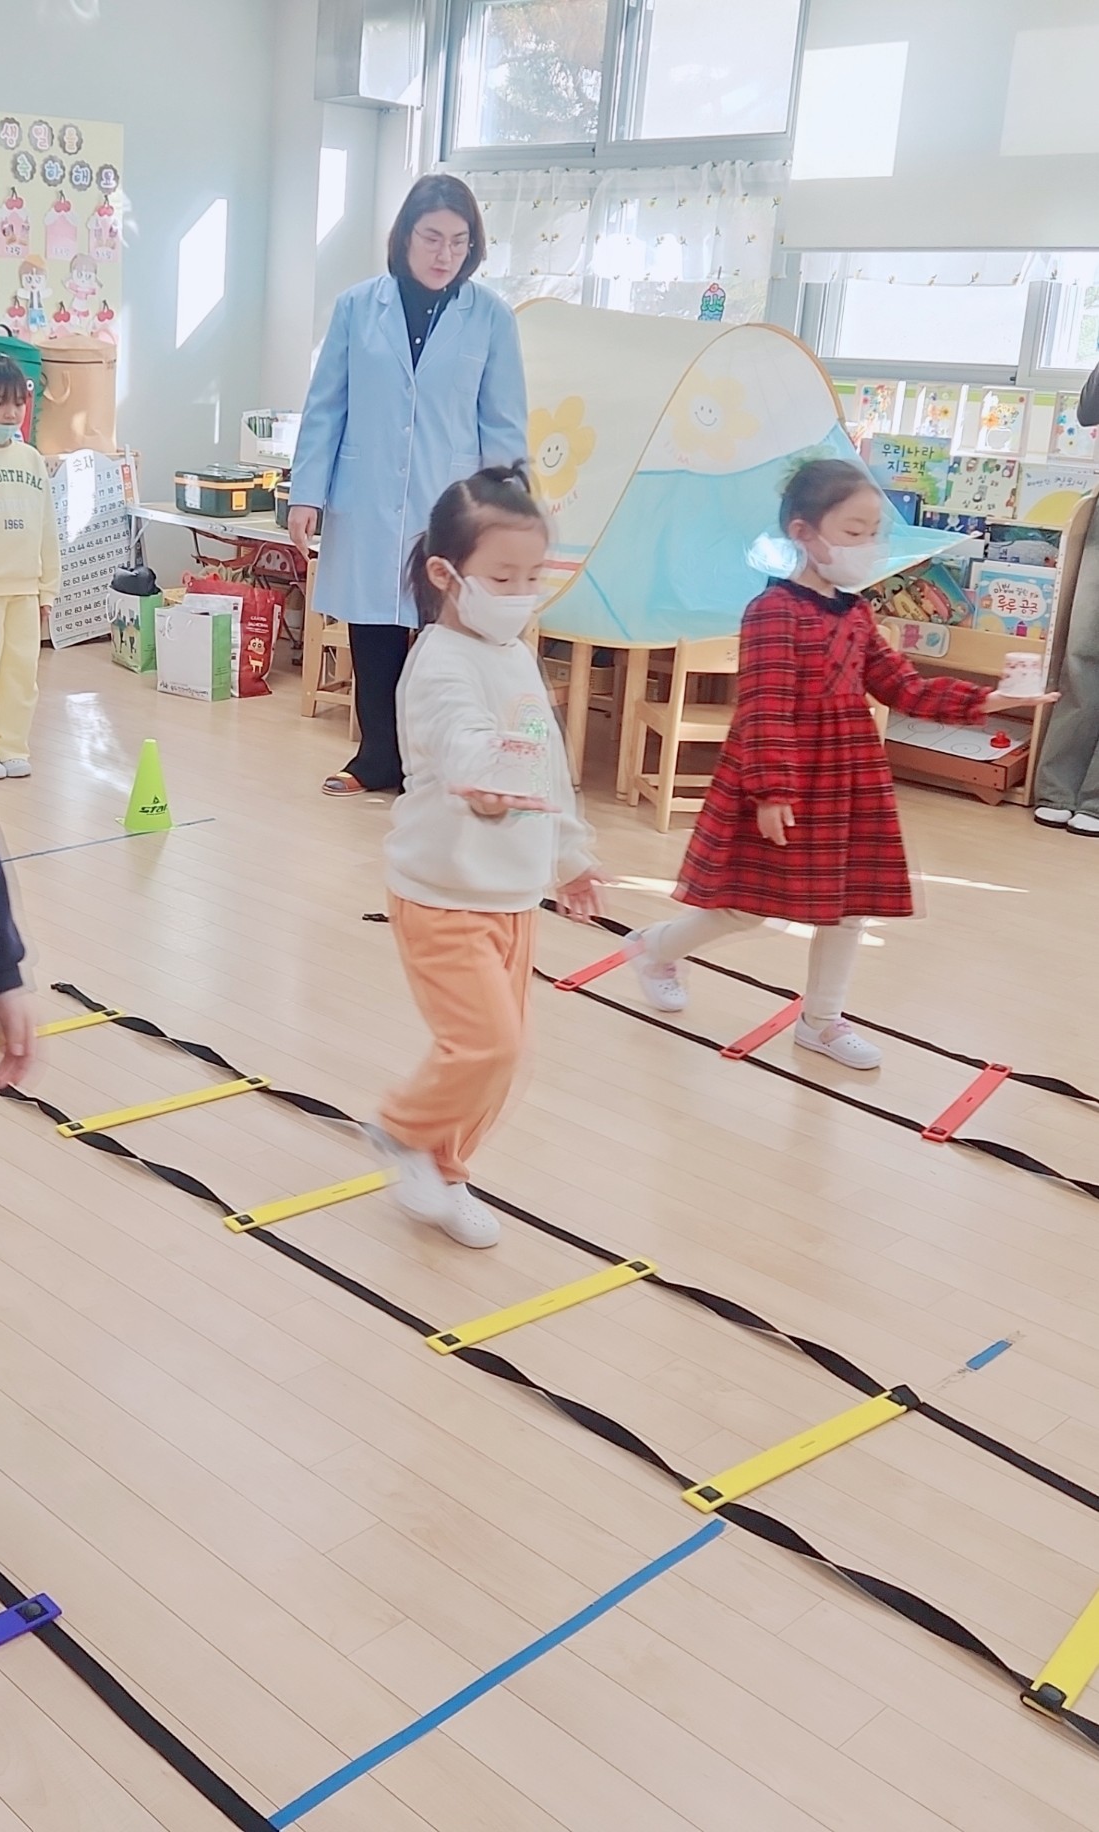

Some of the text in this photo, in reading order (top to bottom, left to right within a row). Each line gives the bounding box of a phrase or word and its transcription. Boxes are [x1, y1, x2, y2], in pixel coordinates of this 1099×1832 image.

[1, 122, 78, 152] 생일을
[17, 153, 117, 189] 축하해요
[882, 444, 934, 459] 우리나라
[887, 460, 926, 476] 지도책
[4, 519, 24, 530] 1966
[998, 595, 1038, 614] 루루 공주
